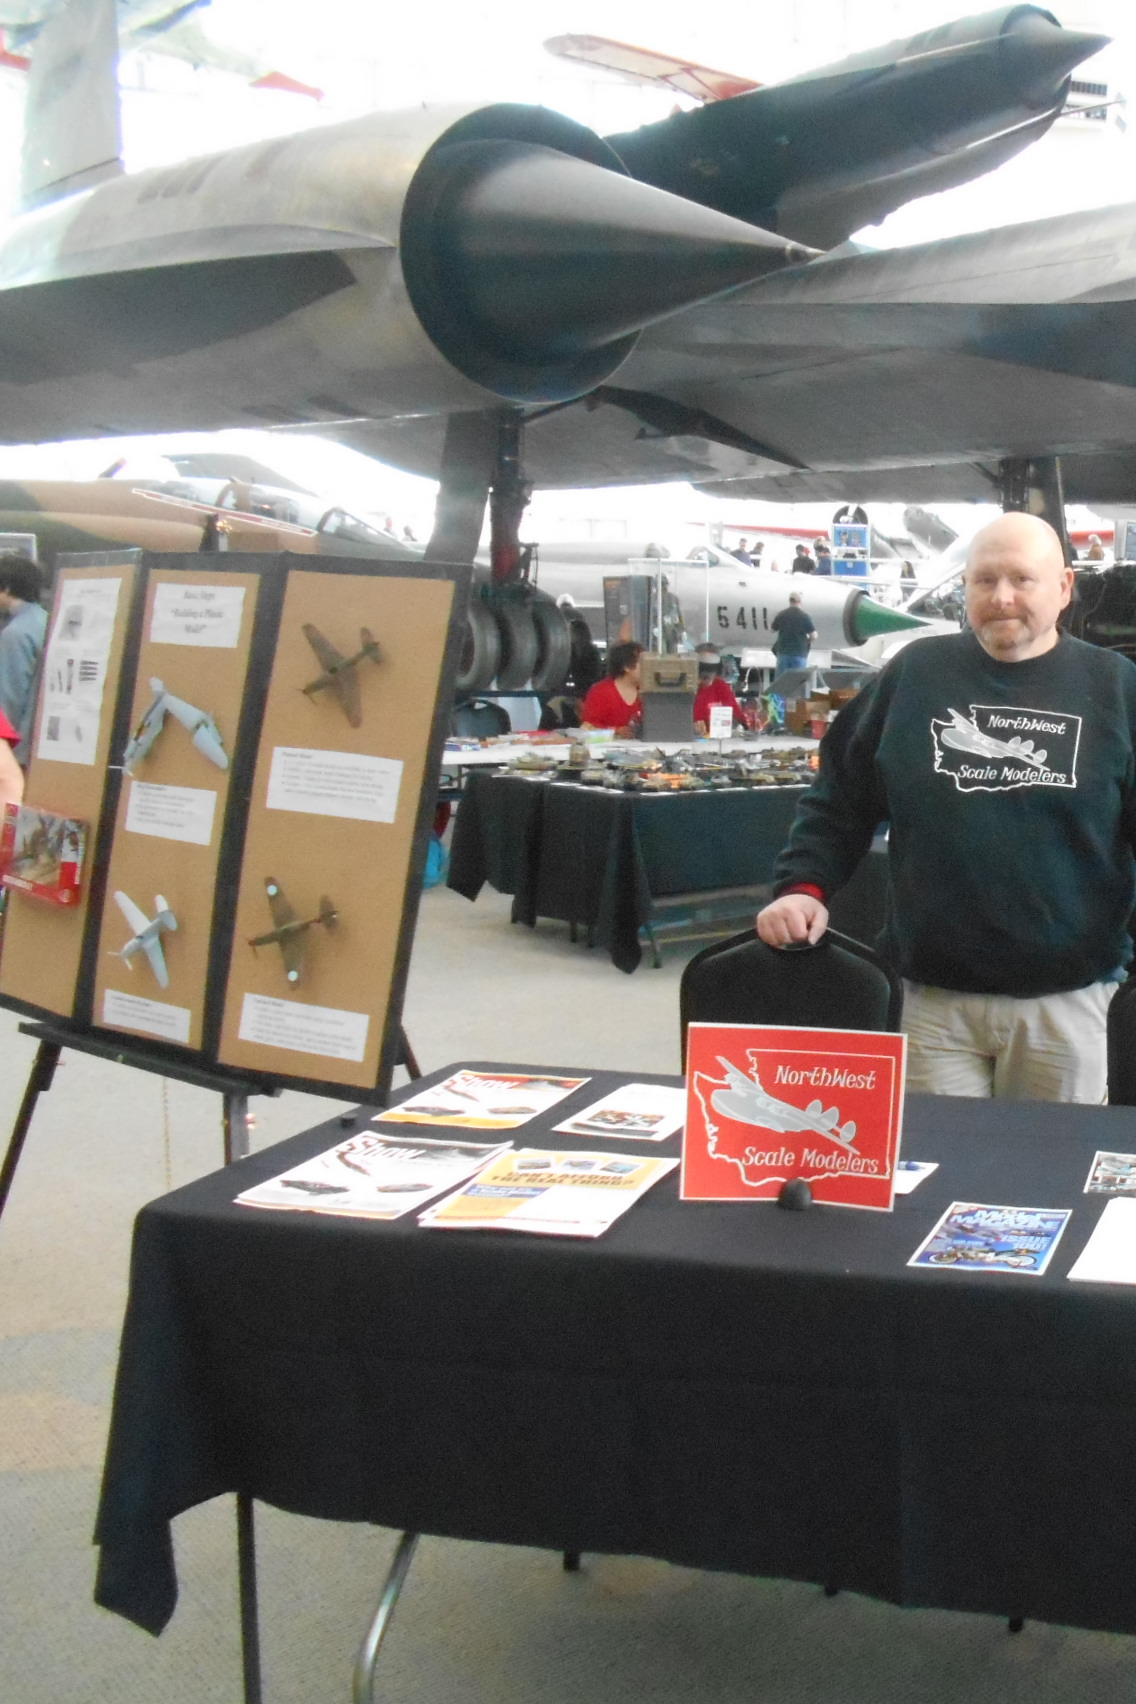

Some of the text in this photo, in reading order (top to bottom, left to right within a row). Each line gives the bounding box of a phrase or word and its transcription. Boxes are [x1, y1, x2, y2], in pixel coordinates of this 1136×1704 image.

[717, 605, 769, 631] 5411
[987, 714, 1067, 735] NorthWest
[958, 764, 1067, 784] Scale Modelers
[774, 1065, 876, 1090] NorthWest
[742, 1146, 879, 1174] Scale Modelers
[948, 1214, 1061, 1229] MAGAZINE
